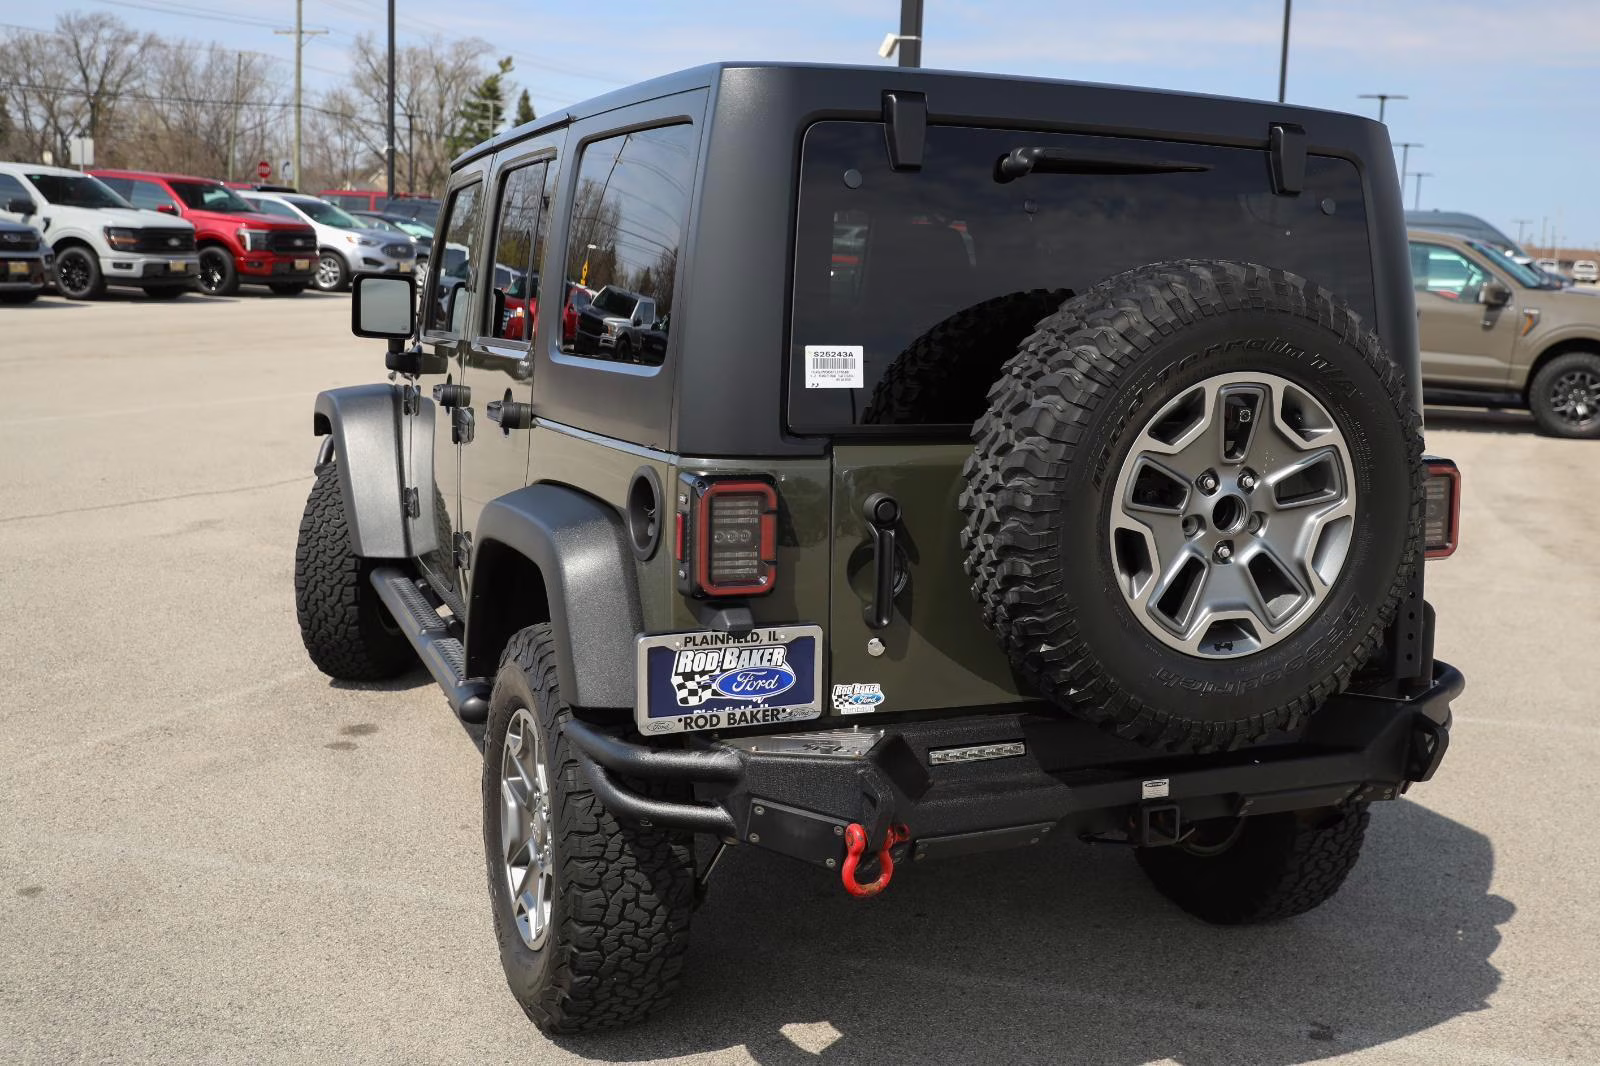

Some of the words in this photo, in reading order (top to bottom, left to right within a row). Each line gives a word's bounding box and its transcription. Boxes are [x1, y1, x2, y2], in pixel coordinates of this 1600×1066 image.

[768, 630, 779, 642] IL
[676, 650, 720, 673] ROD
[722, 647, 785, 672] BAKER
[732, 670, 780, 693] Ford
[857, 694, 878, 703] Ford
